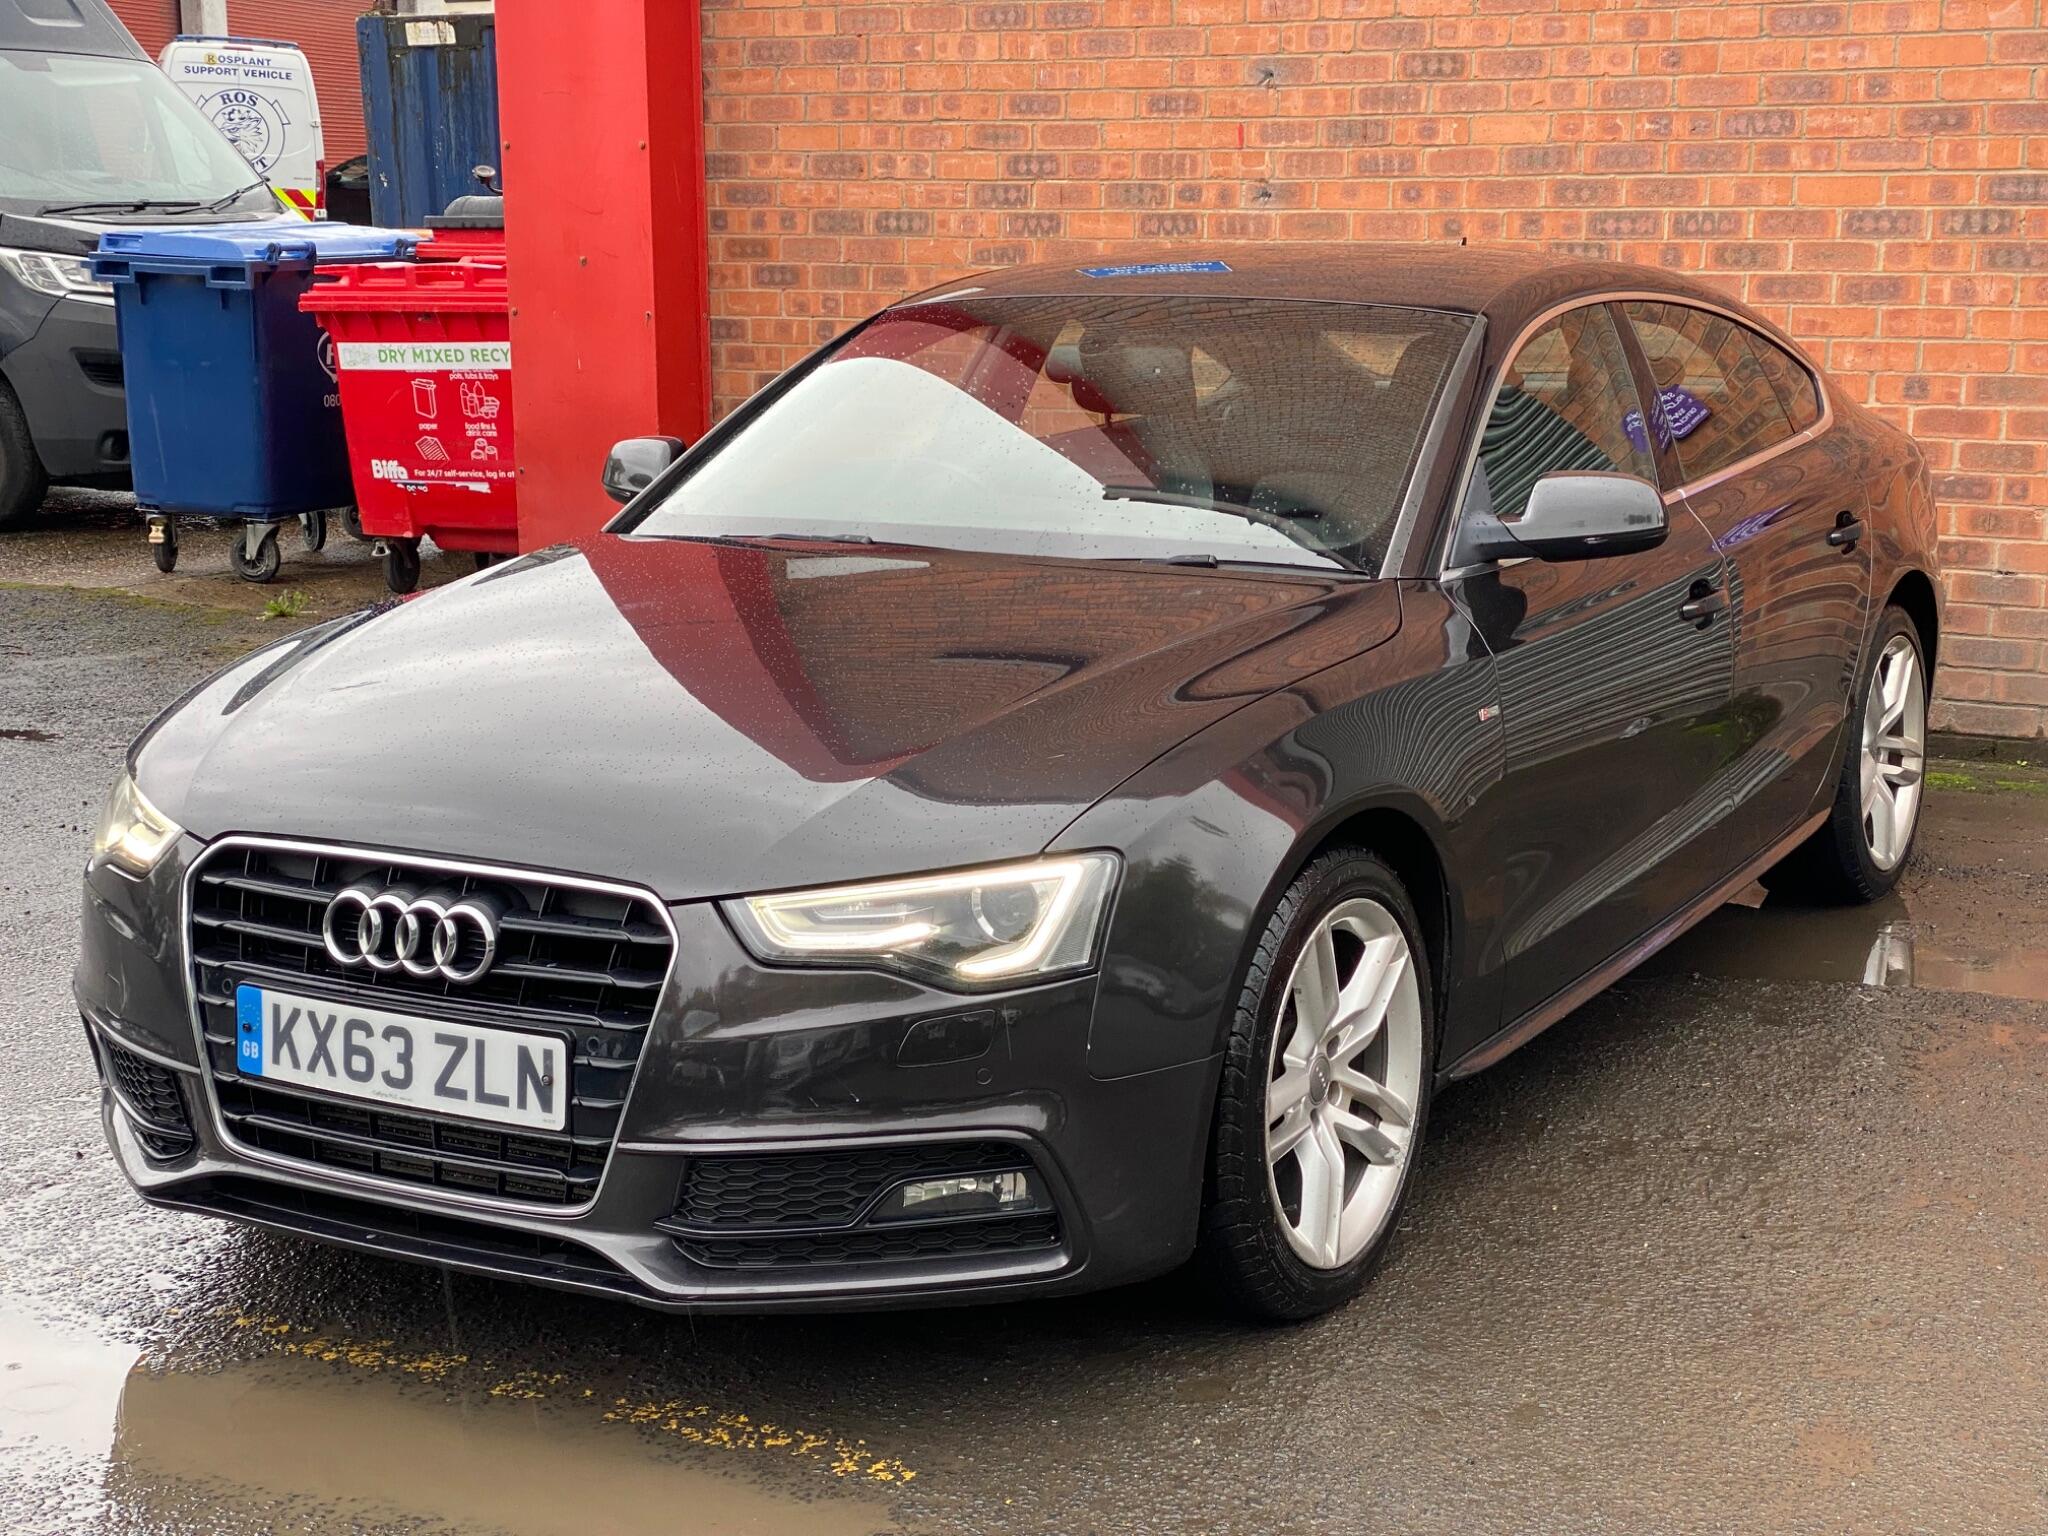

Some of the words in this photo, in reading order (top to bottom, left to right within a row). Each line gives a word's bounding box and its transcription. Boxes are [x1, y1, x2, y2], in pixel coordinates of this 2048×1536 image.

[184, 65, 239, 76] SUPPORT
[243, 69, 293, 81] VEHICLE
[219, 91, 259, 107] ROS
[378, 349, 407, 364] DRY
[412, 348, 465, 364] MIXED
[371, 459, 409, 479] Biffa
[427, 469, 442, 478] 24/7
[486, 470, 498, 479] log
[499, 470, 506, 478] in
[242, 1039, 260, 1060] GB
[271, 1003, 414, 1091] KX63
[433, 1031, 554, 1115] ZLN
